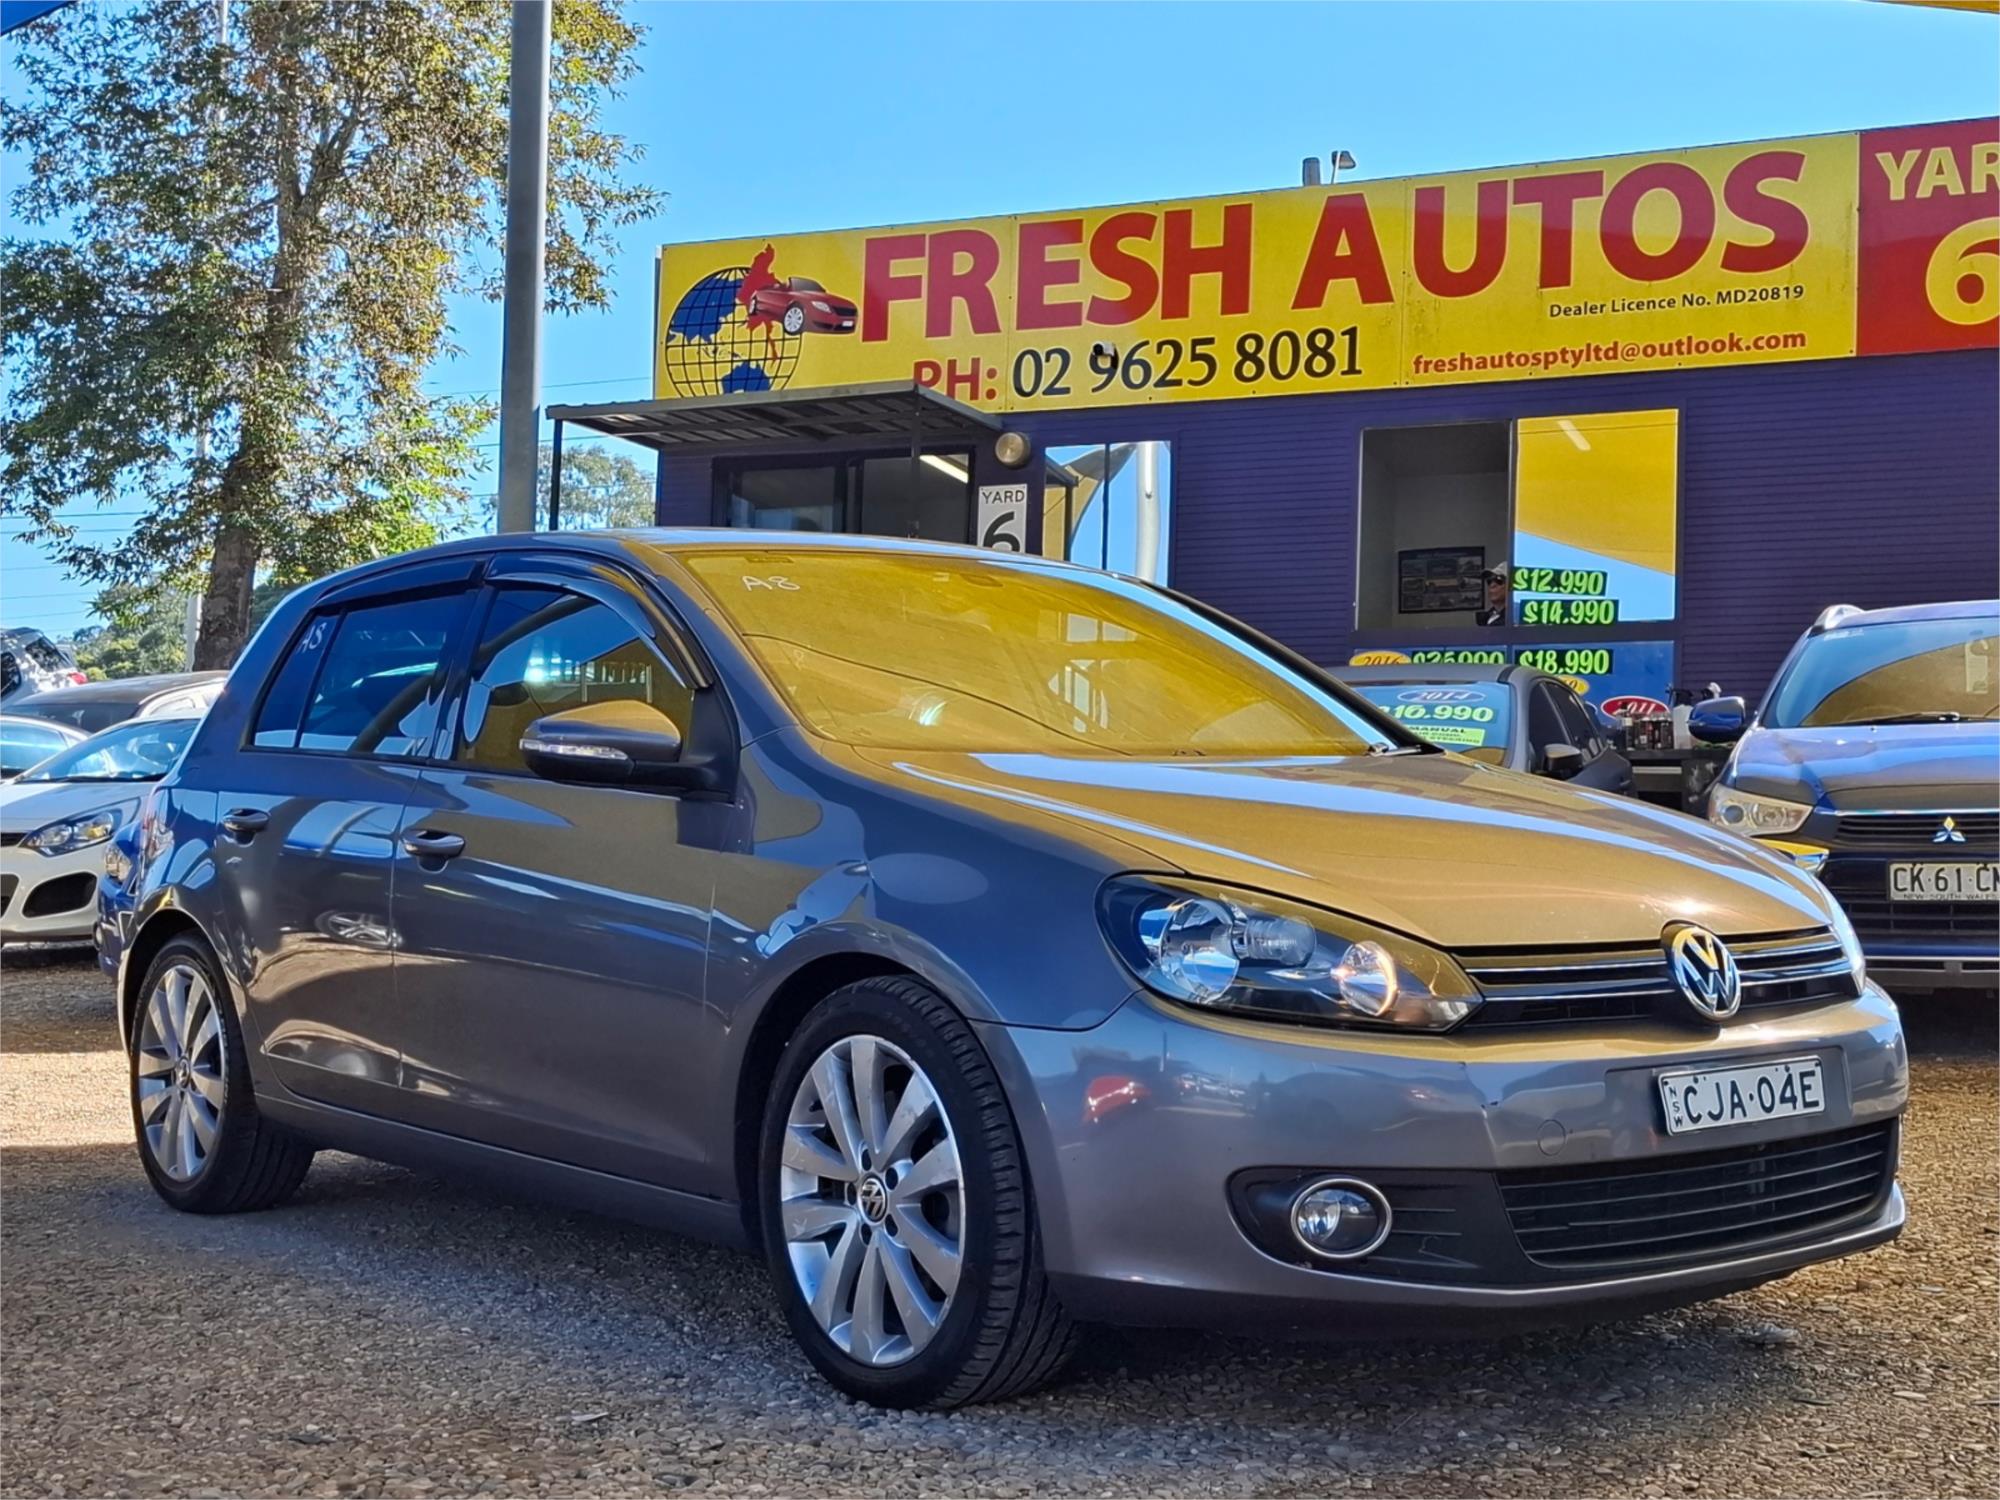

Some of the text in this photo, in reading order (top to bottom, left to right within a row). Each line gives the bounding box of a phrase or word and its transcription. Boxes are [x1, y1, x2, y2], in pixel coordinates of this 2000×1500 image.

[861, 149, 1810, 343] FRESH AUTOS
[1549, 285, 1805, 318] Dealer Licence No. MD20819
[913, 325, 1363, 401] PH: 02 9625 8081
[1412, 332, 1807, 374] freshautosptyltd@outlook.com
[981, 489, 1026, 505] YARD
[982, 510, 1021, 552] 6
